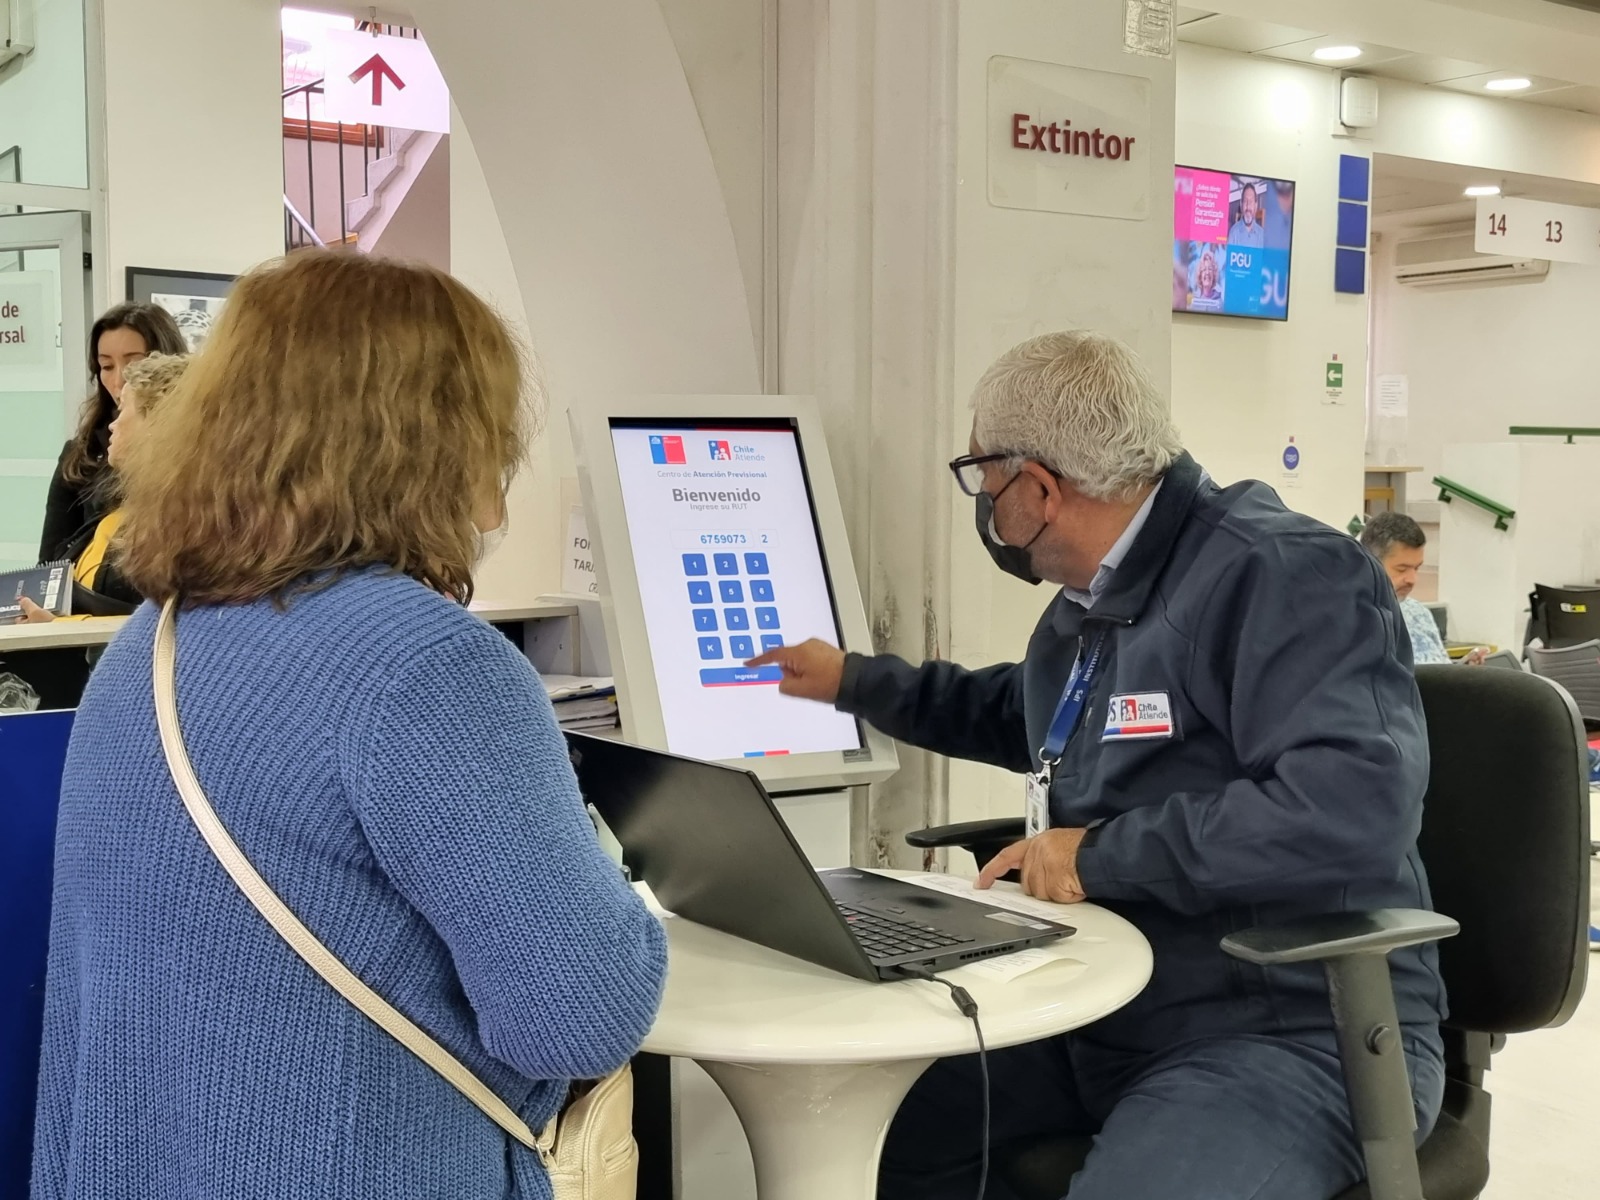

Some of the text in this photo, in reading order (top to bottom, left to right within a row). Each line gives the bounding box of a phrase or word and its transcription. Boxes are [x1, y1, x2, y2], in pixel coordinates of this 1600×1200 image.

[1012, 113, 1135, 161] Extintor
[1489, 213, 1563, 243] 14 13
[1230, 252, 1251, 268] PGU
[1, 300, 19, 318] de
[733, 445, 755, 454] Chile
[735, 453, 766, 461] Atiende
[657, 470, 682, 478] Centro
[682, 470, 692, 478] de
[693, 470, 726, 478] Atención
[672, 488, 761, 502] Bienvenido
[690, 503, 719, 511] Ingrese
[700, 534, 768, 544] 6759073 2
[707, 644, 714, 652] K
[1073, 689, 1084, 702] IPS
[1083, 641, 1103, 682] INSTITUTO
[1138, 703, 1158, 711] Chile
[1139, 711, 1169, 721] Atiende
